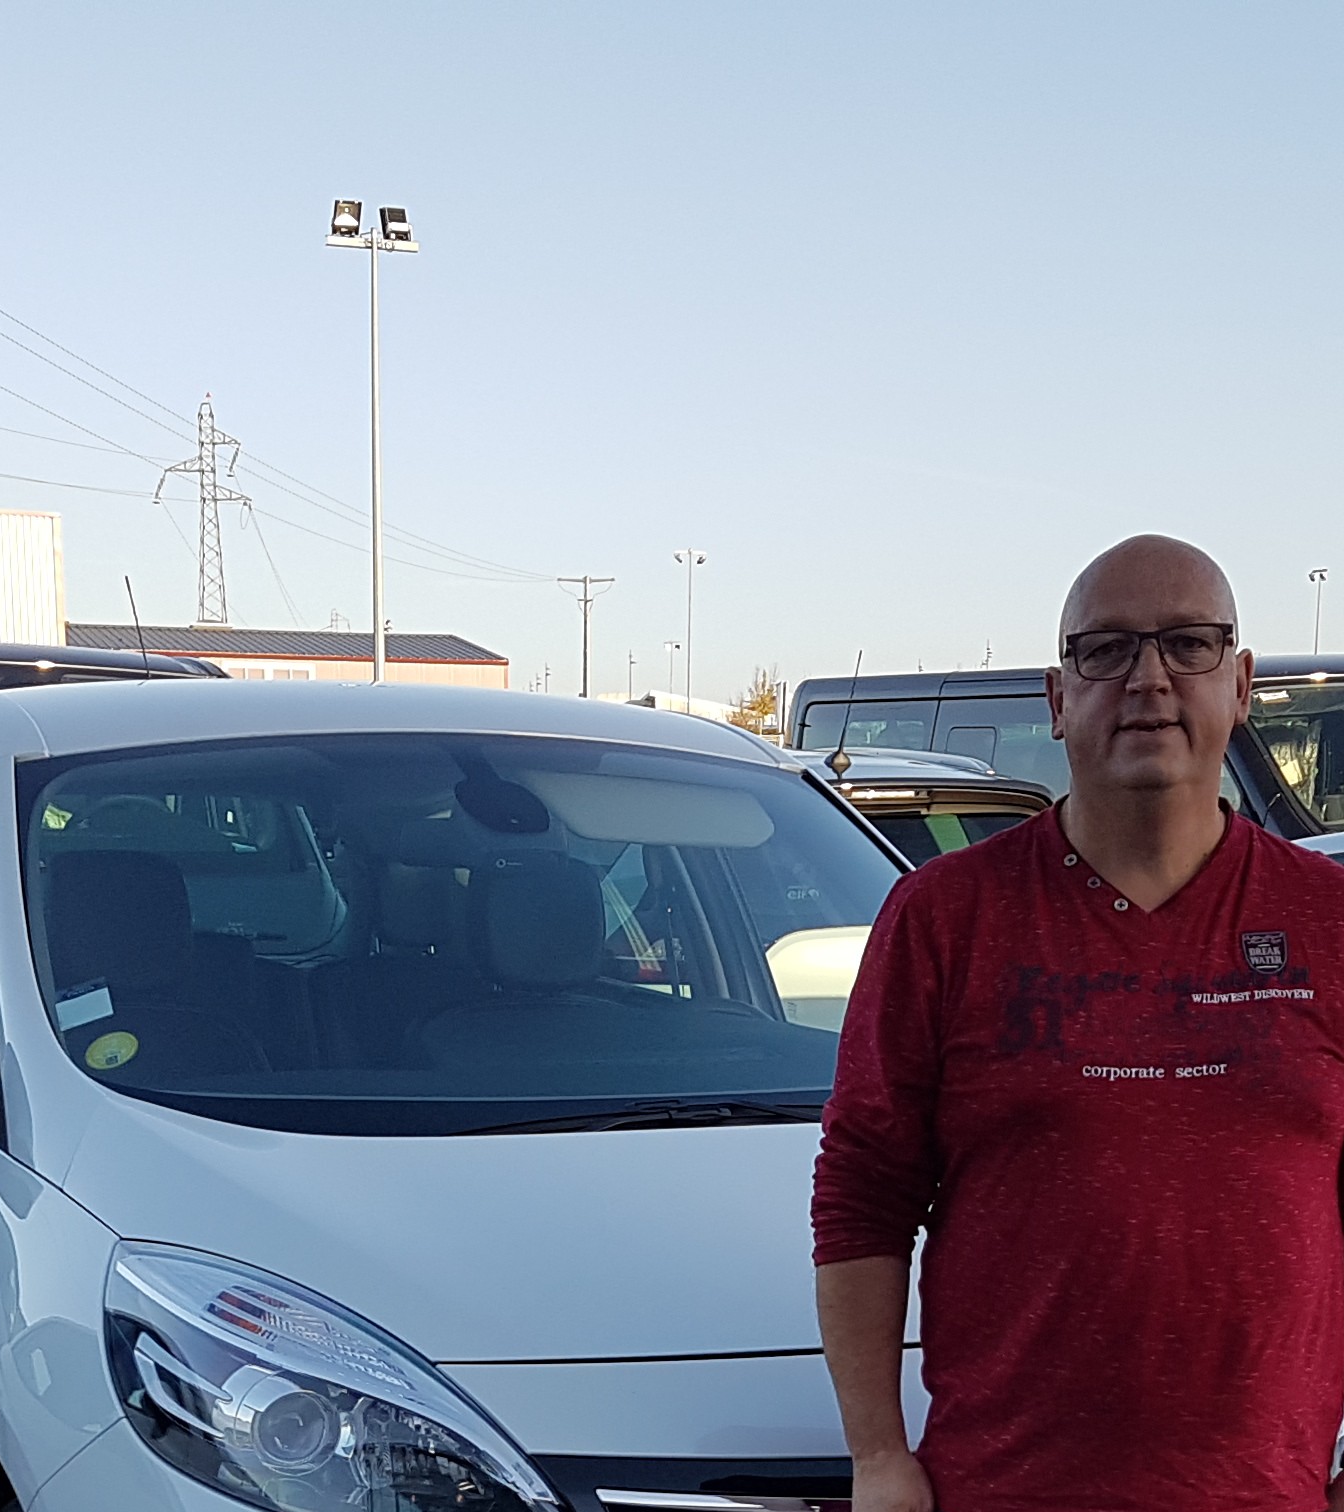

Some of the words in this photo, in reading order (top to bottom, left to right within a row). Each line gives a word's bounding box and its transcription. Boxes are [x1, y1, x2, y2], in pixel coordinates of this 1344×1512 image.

[1191, 991, 1251, 1004] WILDWEST
[1253, 988, 1315, 1000] DISCOVERY
[1082, 1064, 1165, 1081] corporate
[1175, 1062, 1228, 1079] sector
